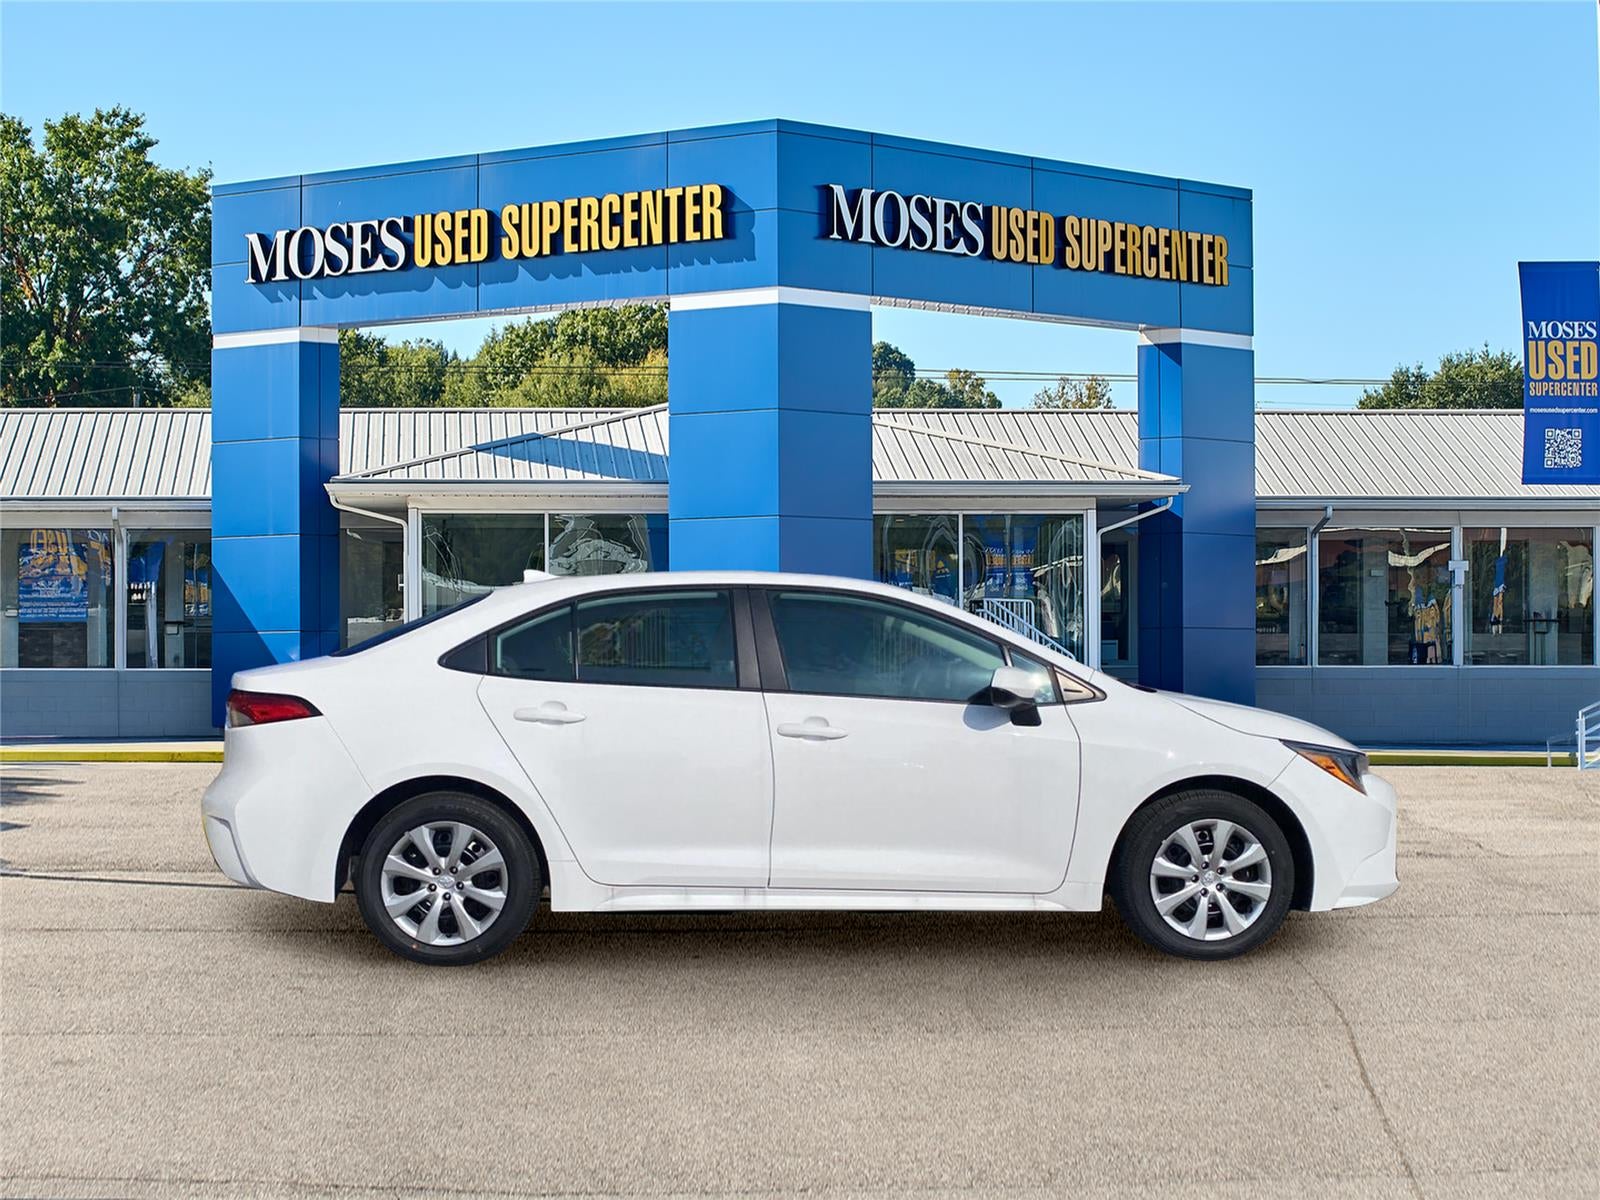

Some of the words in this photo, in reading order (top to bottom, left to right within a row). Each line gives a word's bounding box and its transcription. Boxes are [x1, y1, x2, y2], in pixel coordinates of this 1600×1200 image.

[244, 216, 408, 283] MOSES
[413, 208, 488, 268] USED
[501, 184, 723, 260] SUPERCENTER
[829, 183, 984, 257] MOSES
[991, 205, 1054, 265] USED
[1065, 215, 1229, 286] SUPERCENTER
[1528, 321, 1597, 339] MOSES
[1528, 341, 1598, 380] USED
[1529, 382, 1598, 397] SUPERCENTER
